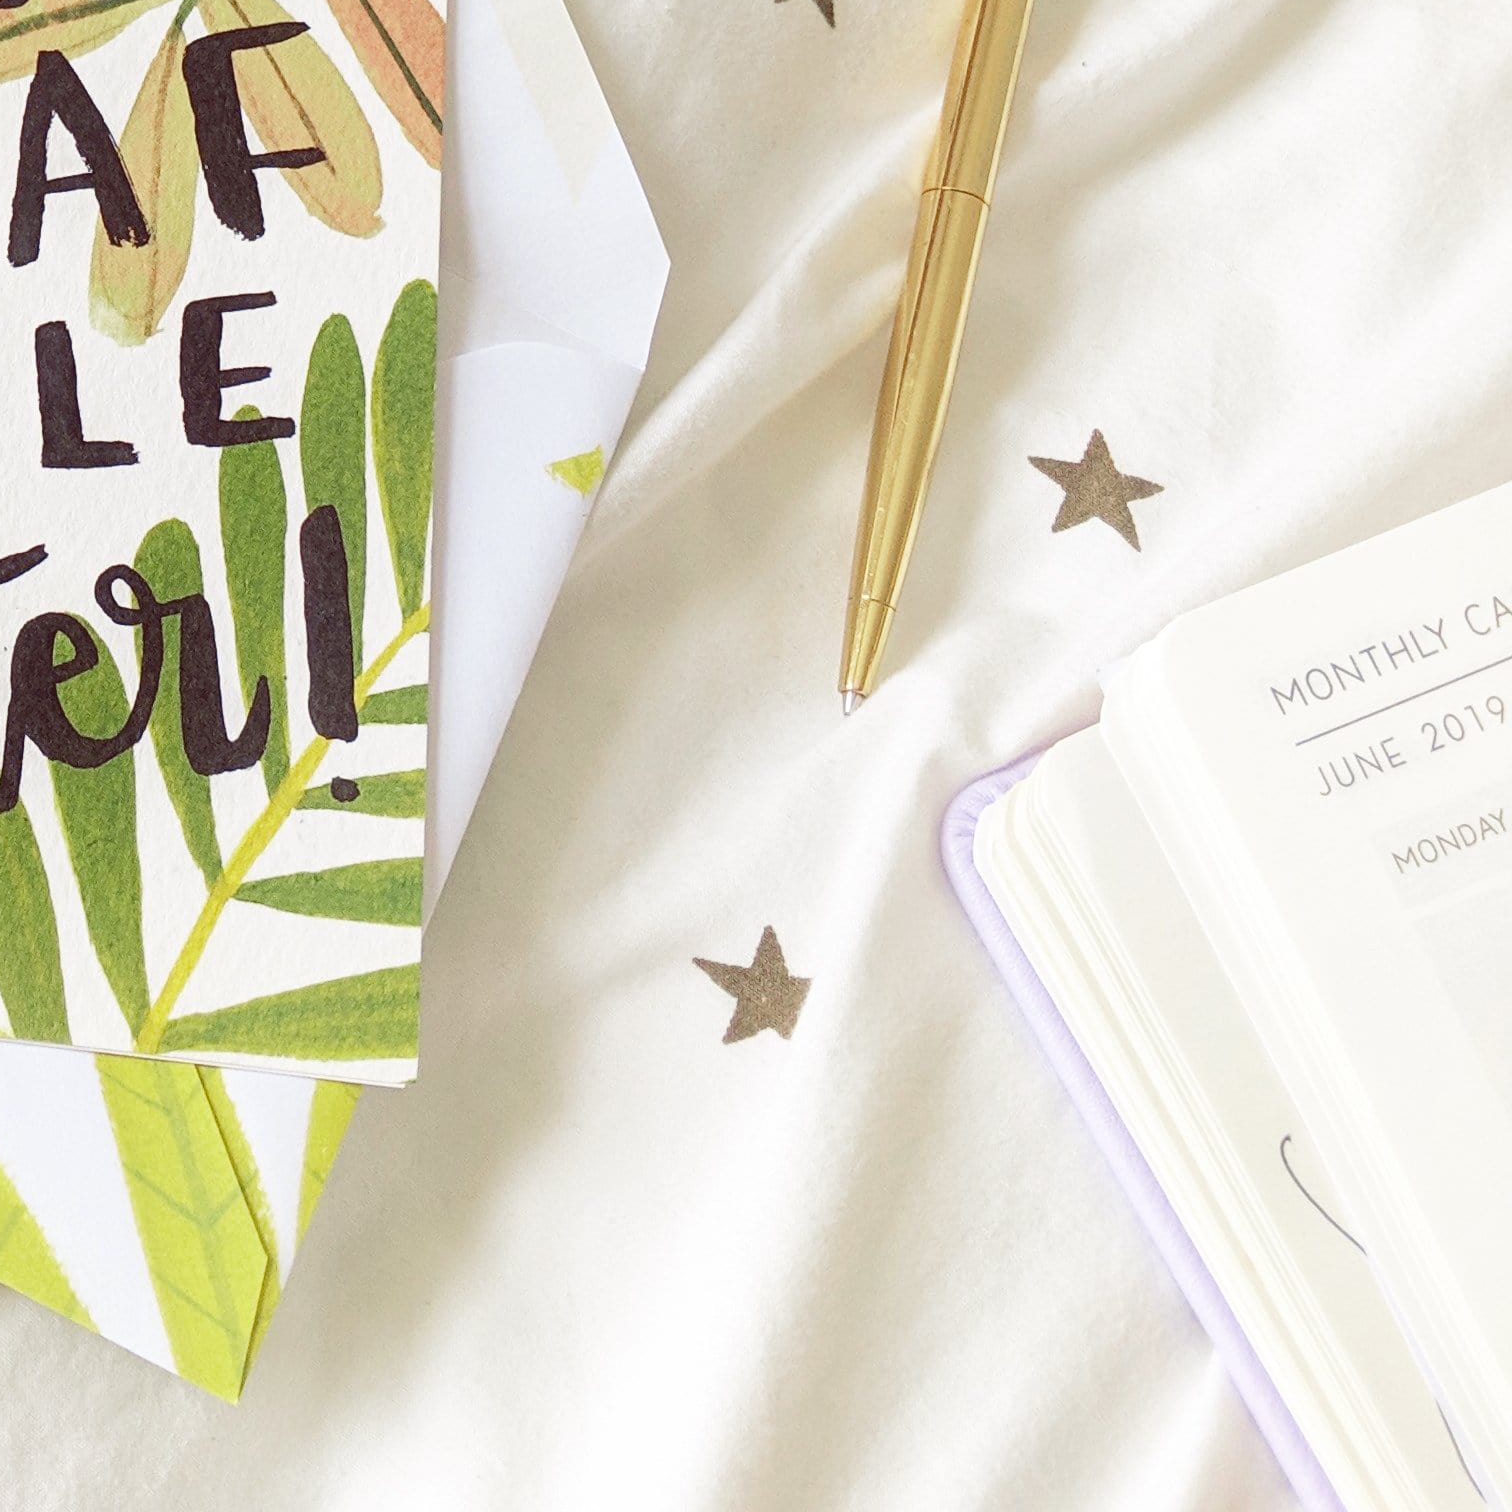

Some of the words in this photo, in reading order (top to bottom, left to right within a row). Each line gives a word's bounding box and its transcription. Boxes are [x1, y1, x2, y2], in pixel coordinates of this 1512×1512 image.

[1269, 617, 1449, 716] MONTHLY
[1317, 736, 1408, 797] JUNE
[1420, 695, 1506, 753] 2019
[1391, 807, 1508, 875] MONDAY
